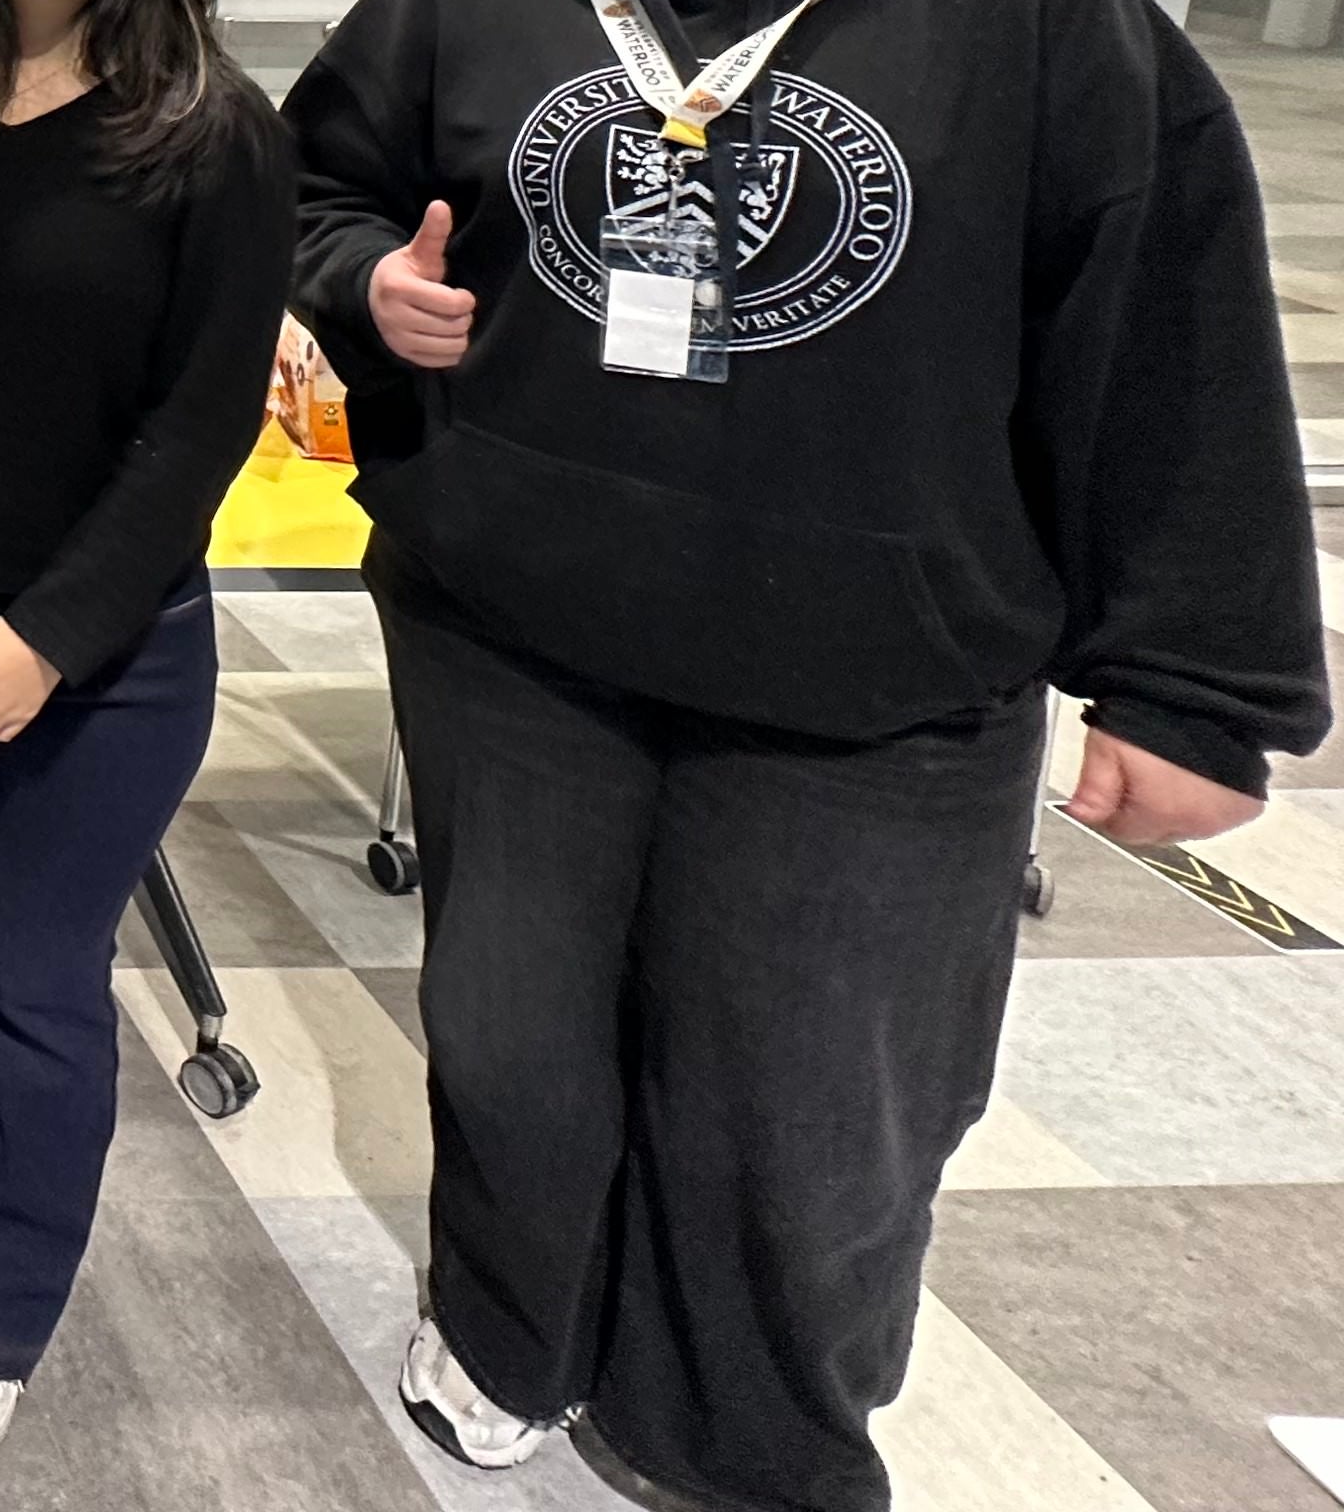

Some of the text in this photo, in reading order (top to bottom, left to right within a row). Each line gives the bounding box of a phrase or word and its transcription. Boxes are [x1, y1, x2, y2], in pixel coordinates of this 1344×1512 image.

[616, 18, 661, 86] WATERLOO
[523, 76, 894, 261] UNIVERSIT WATERLOO
[538, 224, 852, 332] CONCOR VERITATE
